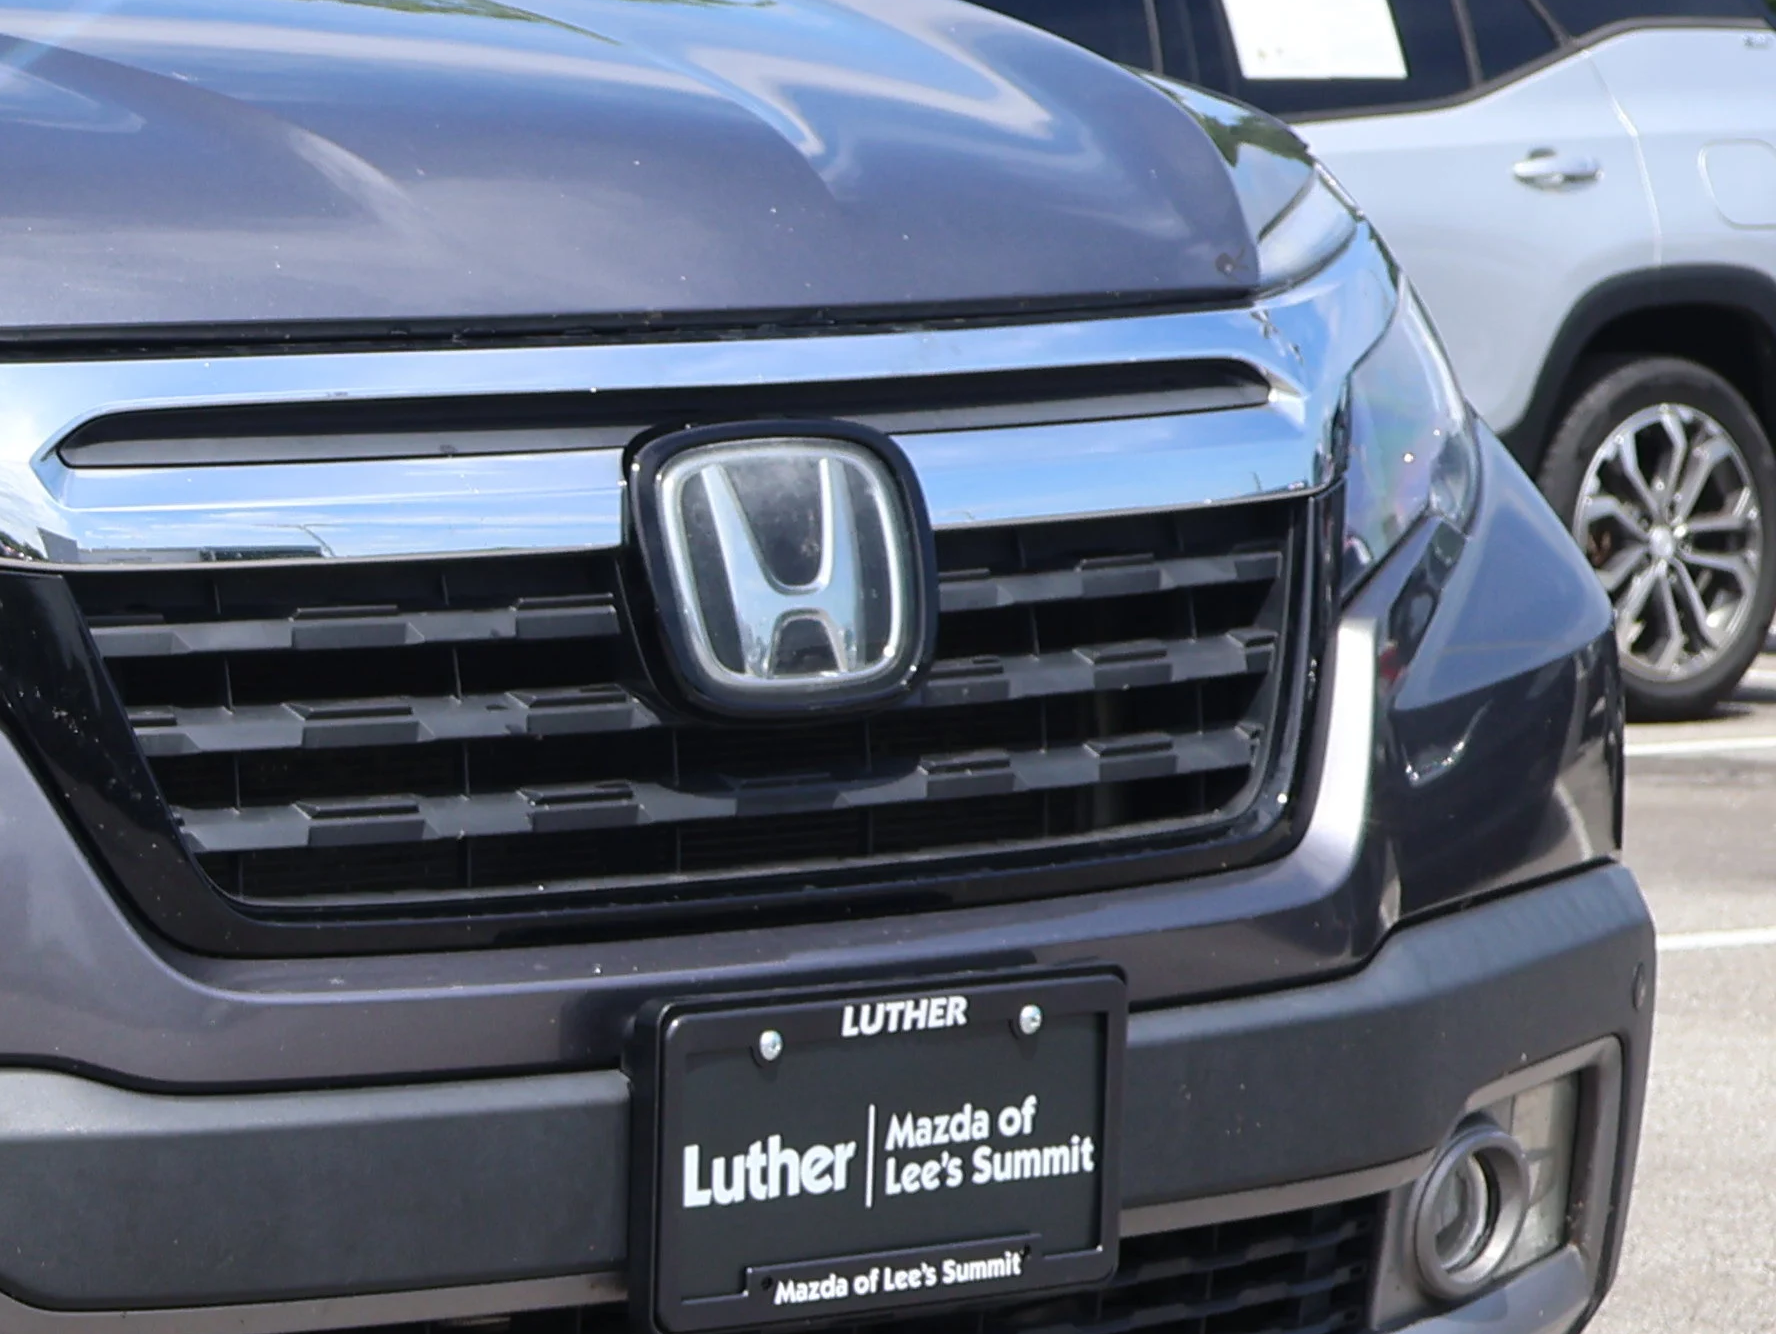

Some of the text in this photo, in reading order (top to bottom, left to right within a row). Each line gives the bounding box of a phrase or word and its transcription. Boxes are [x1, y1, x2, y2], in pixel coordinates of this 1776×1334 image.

[841, 996, 968, 1037] LUTHER
[884, 1094, 1037, 1152] Mazda of
[683, 1134, 857, 1208] Luther
[885, 1134, 1095, 1195] Lee's Summit
[774, 1250, 1022, 1305] Mazda of Lee's Summit
